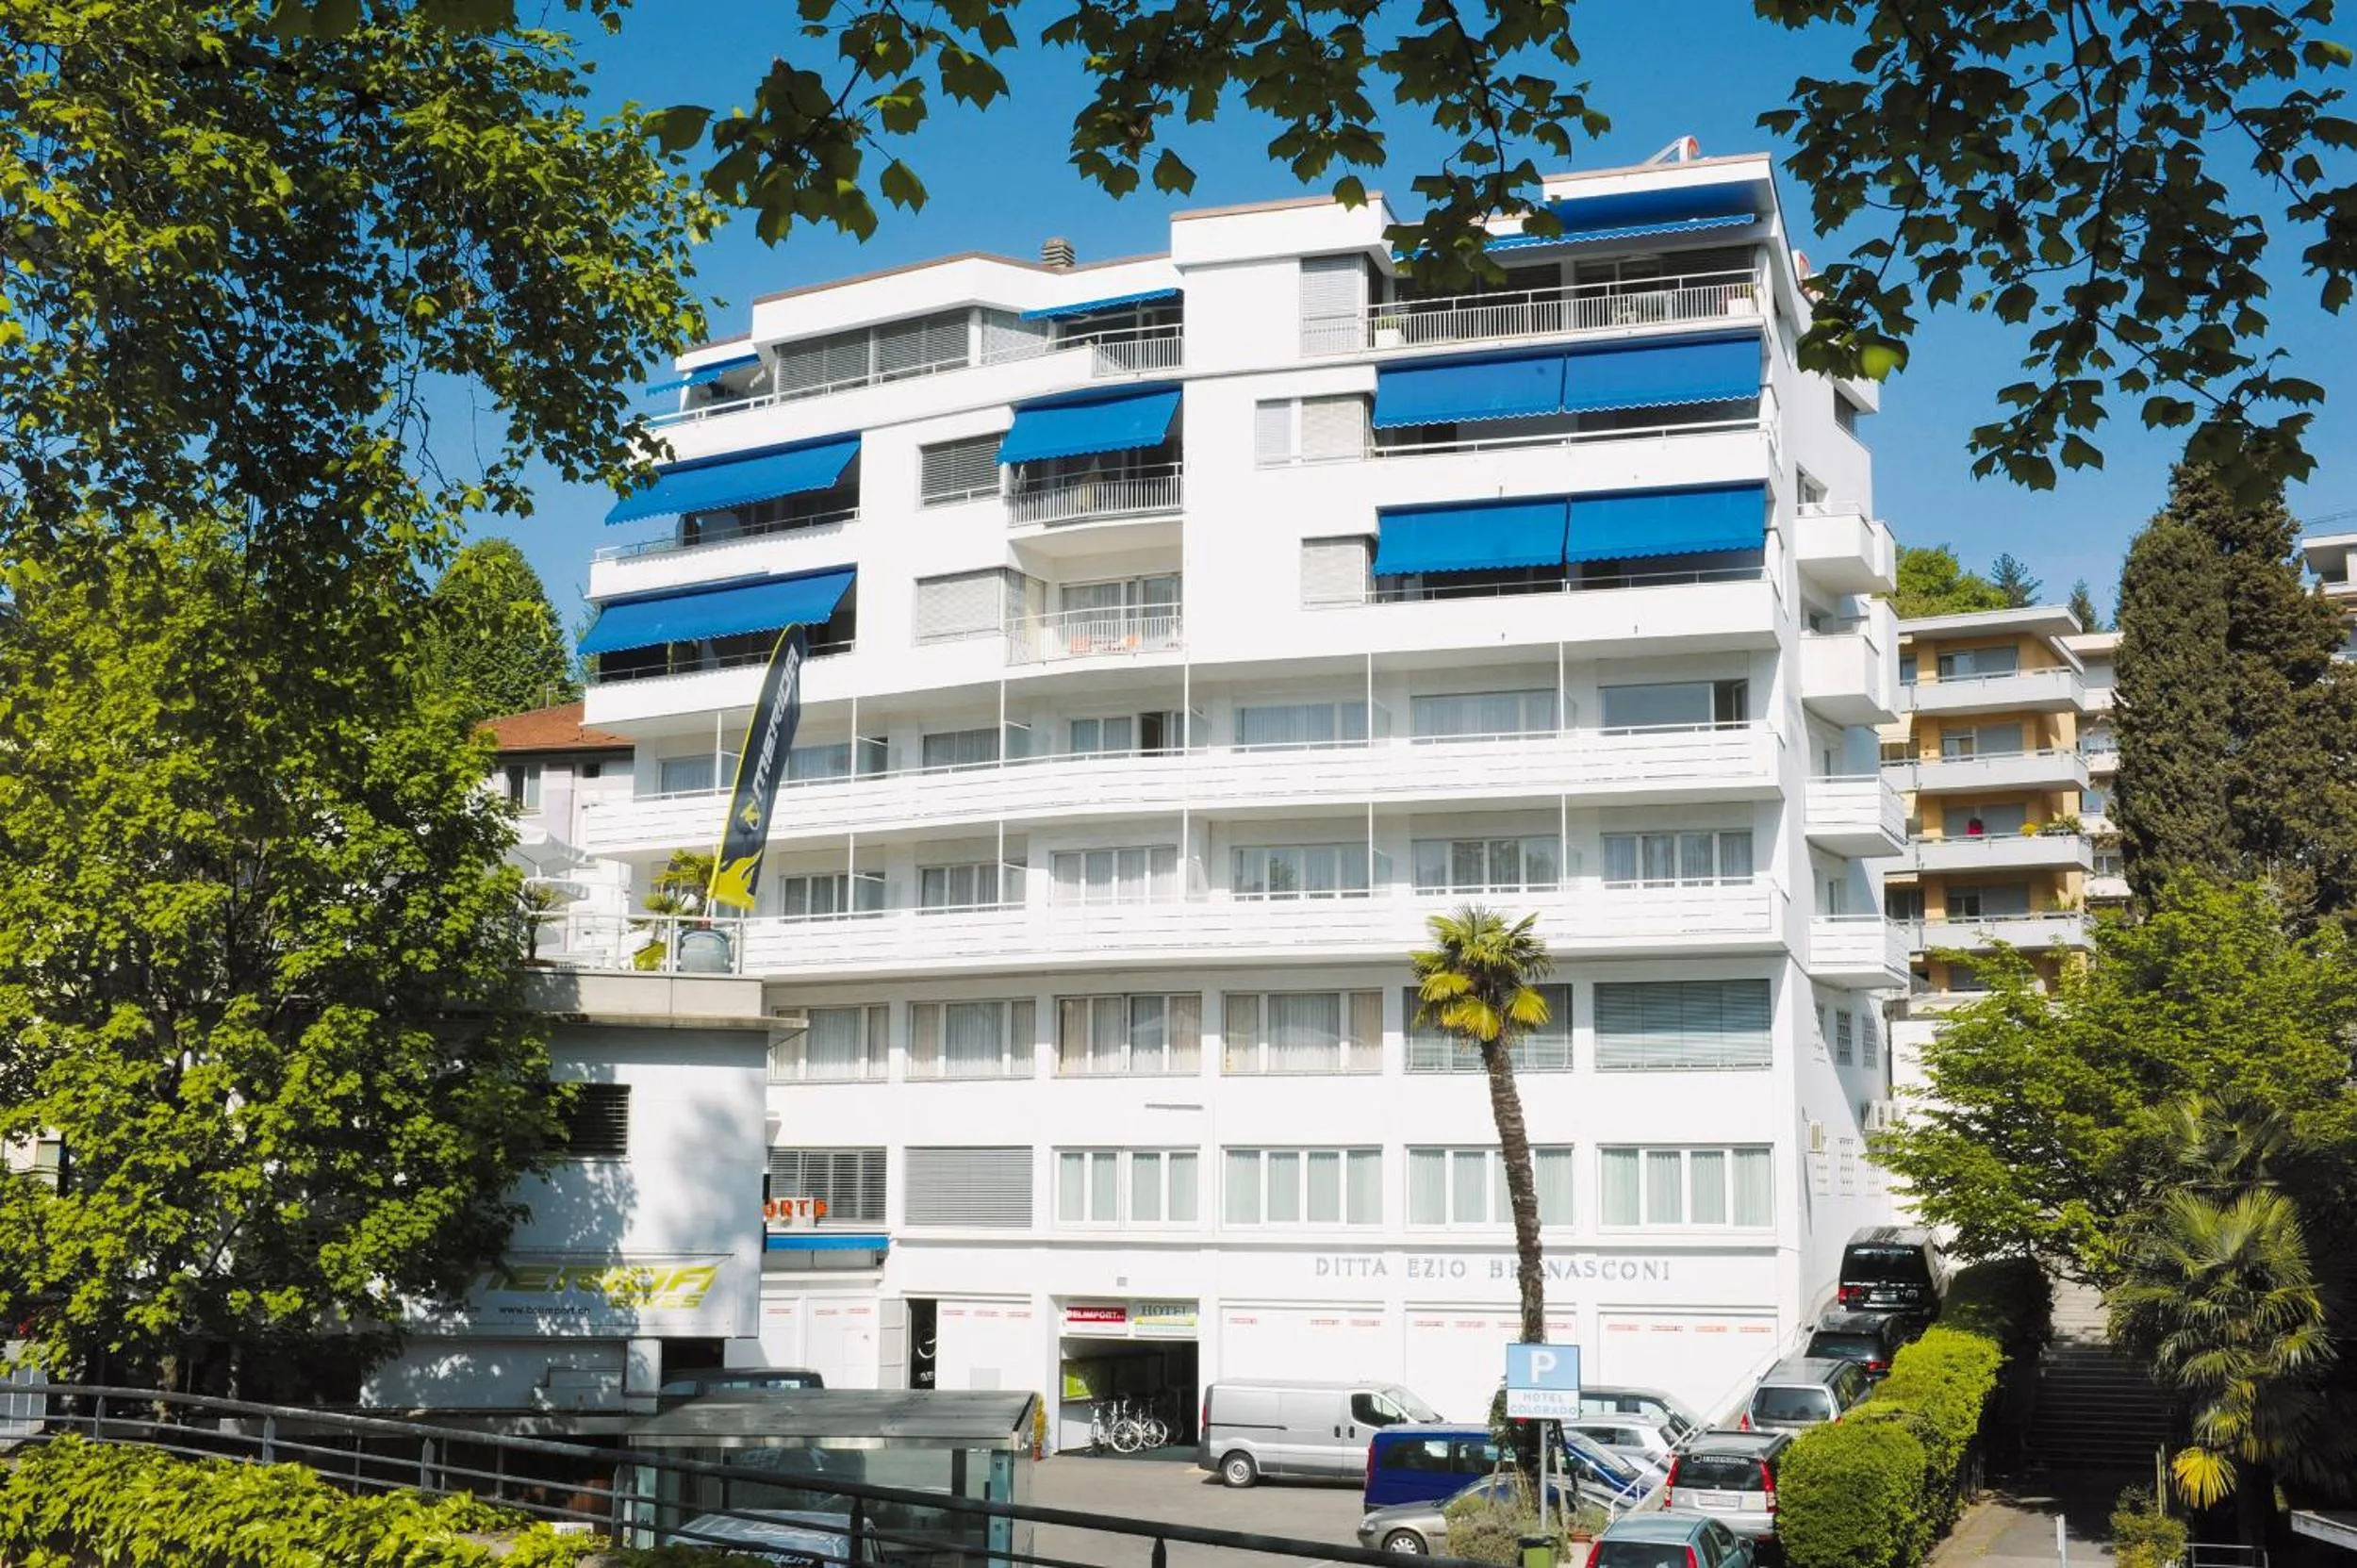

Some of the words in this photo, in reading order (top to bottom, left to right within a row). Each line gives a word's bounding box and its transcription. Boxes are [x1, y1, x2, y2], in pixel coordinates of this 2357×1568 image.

[1315, 1257, 1388, 1277] DITTA
[1408, 1259, 1466, 1278] EZIO
[1530, 1350, 1558, 1383] P
[1523, 1393, 1563, 1403] HOTEL
[1509, 1404, 1577, 1415] COLORADO
